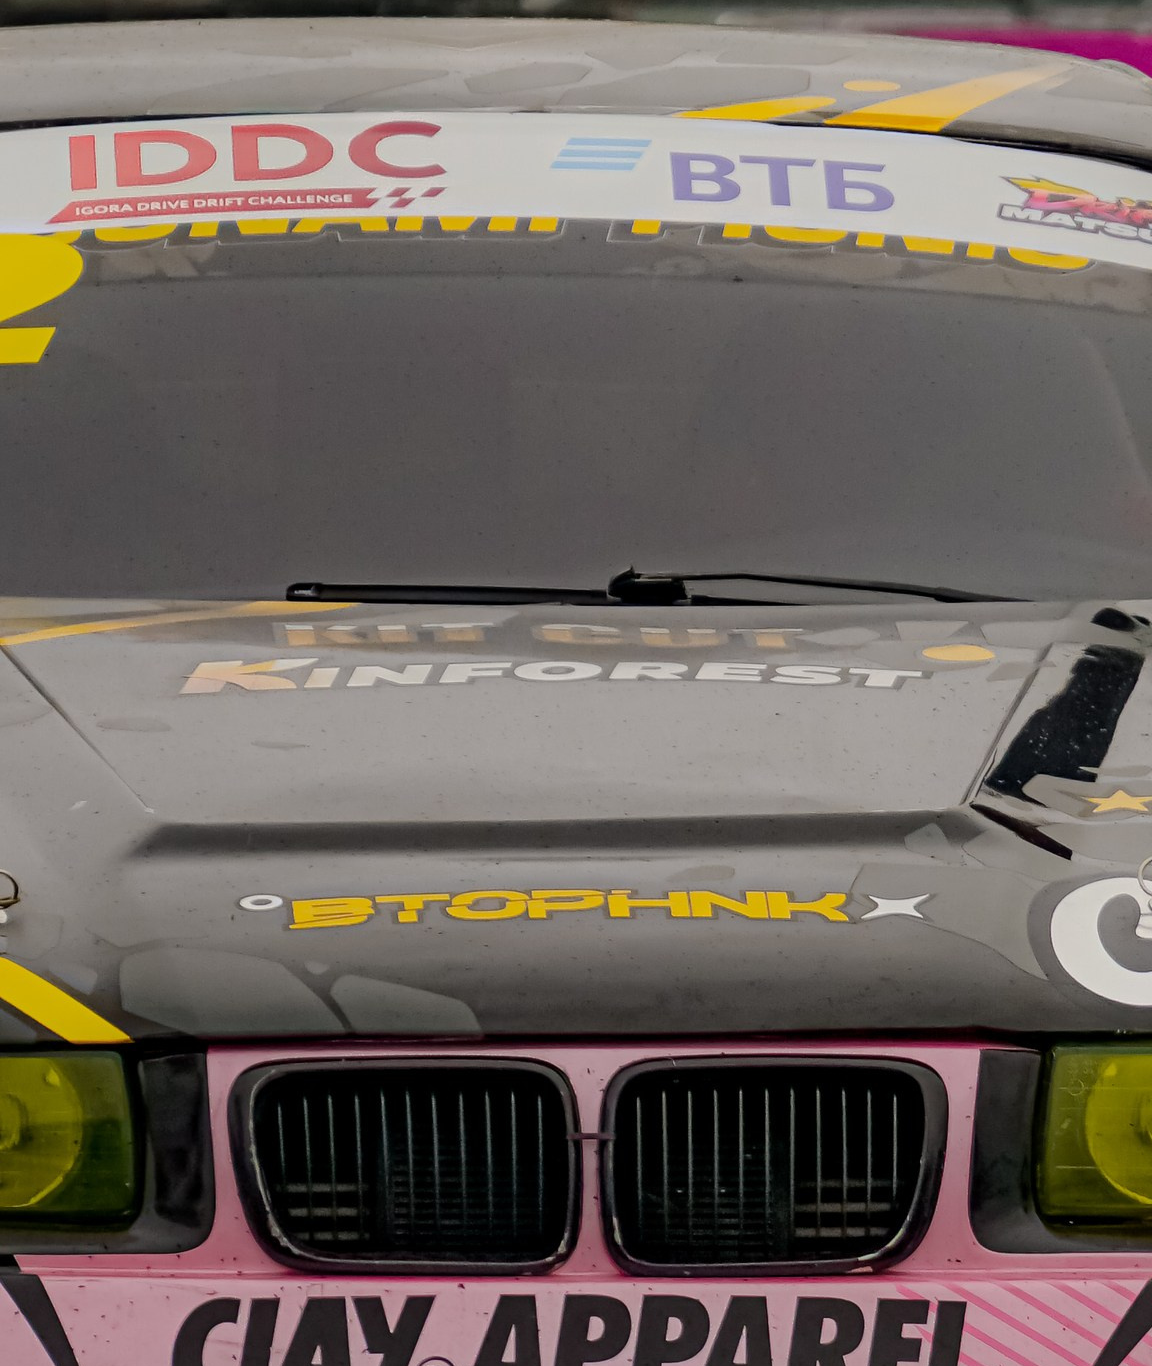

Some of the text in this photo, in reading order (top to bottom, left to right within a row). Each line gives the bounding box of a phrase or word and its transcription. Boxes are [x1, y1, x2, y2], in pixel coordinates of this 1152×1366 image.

[68, 120, 448, 191] IDDC
[74, 192, 353, 217] IGORA DRIVE DRIFT CHALLENGE
[669, 151, 895, 212] ВТБ
[178, 657, 923, 695] KINFOREST
